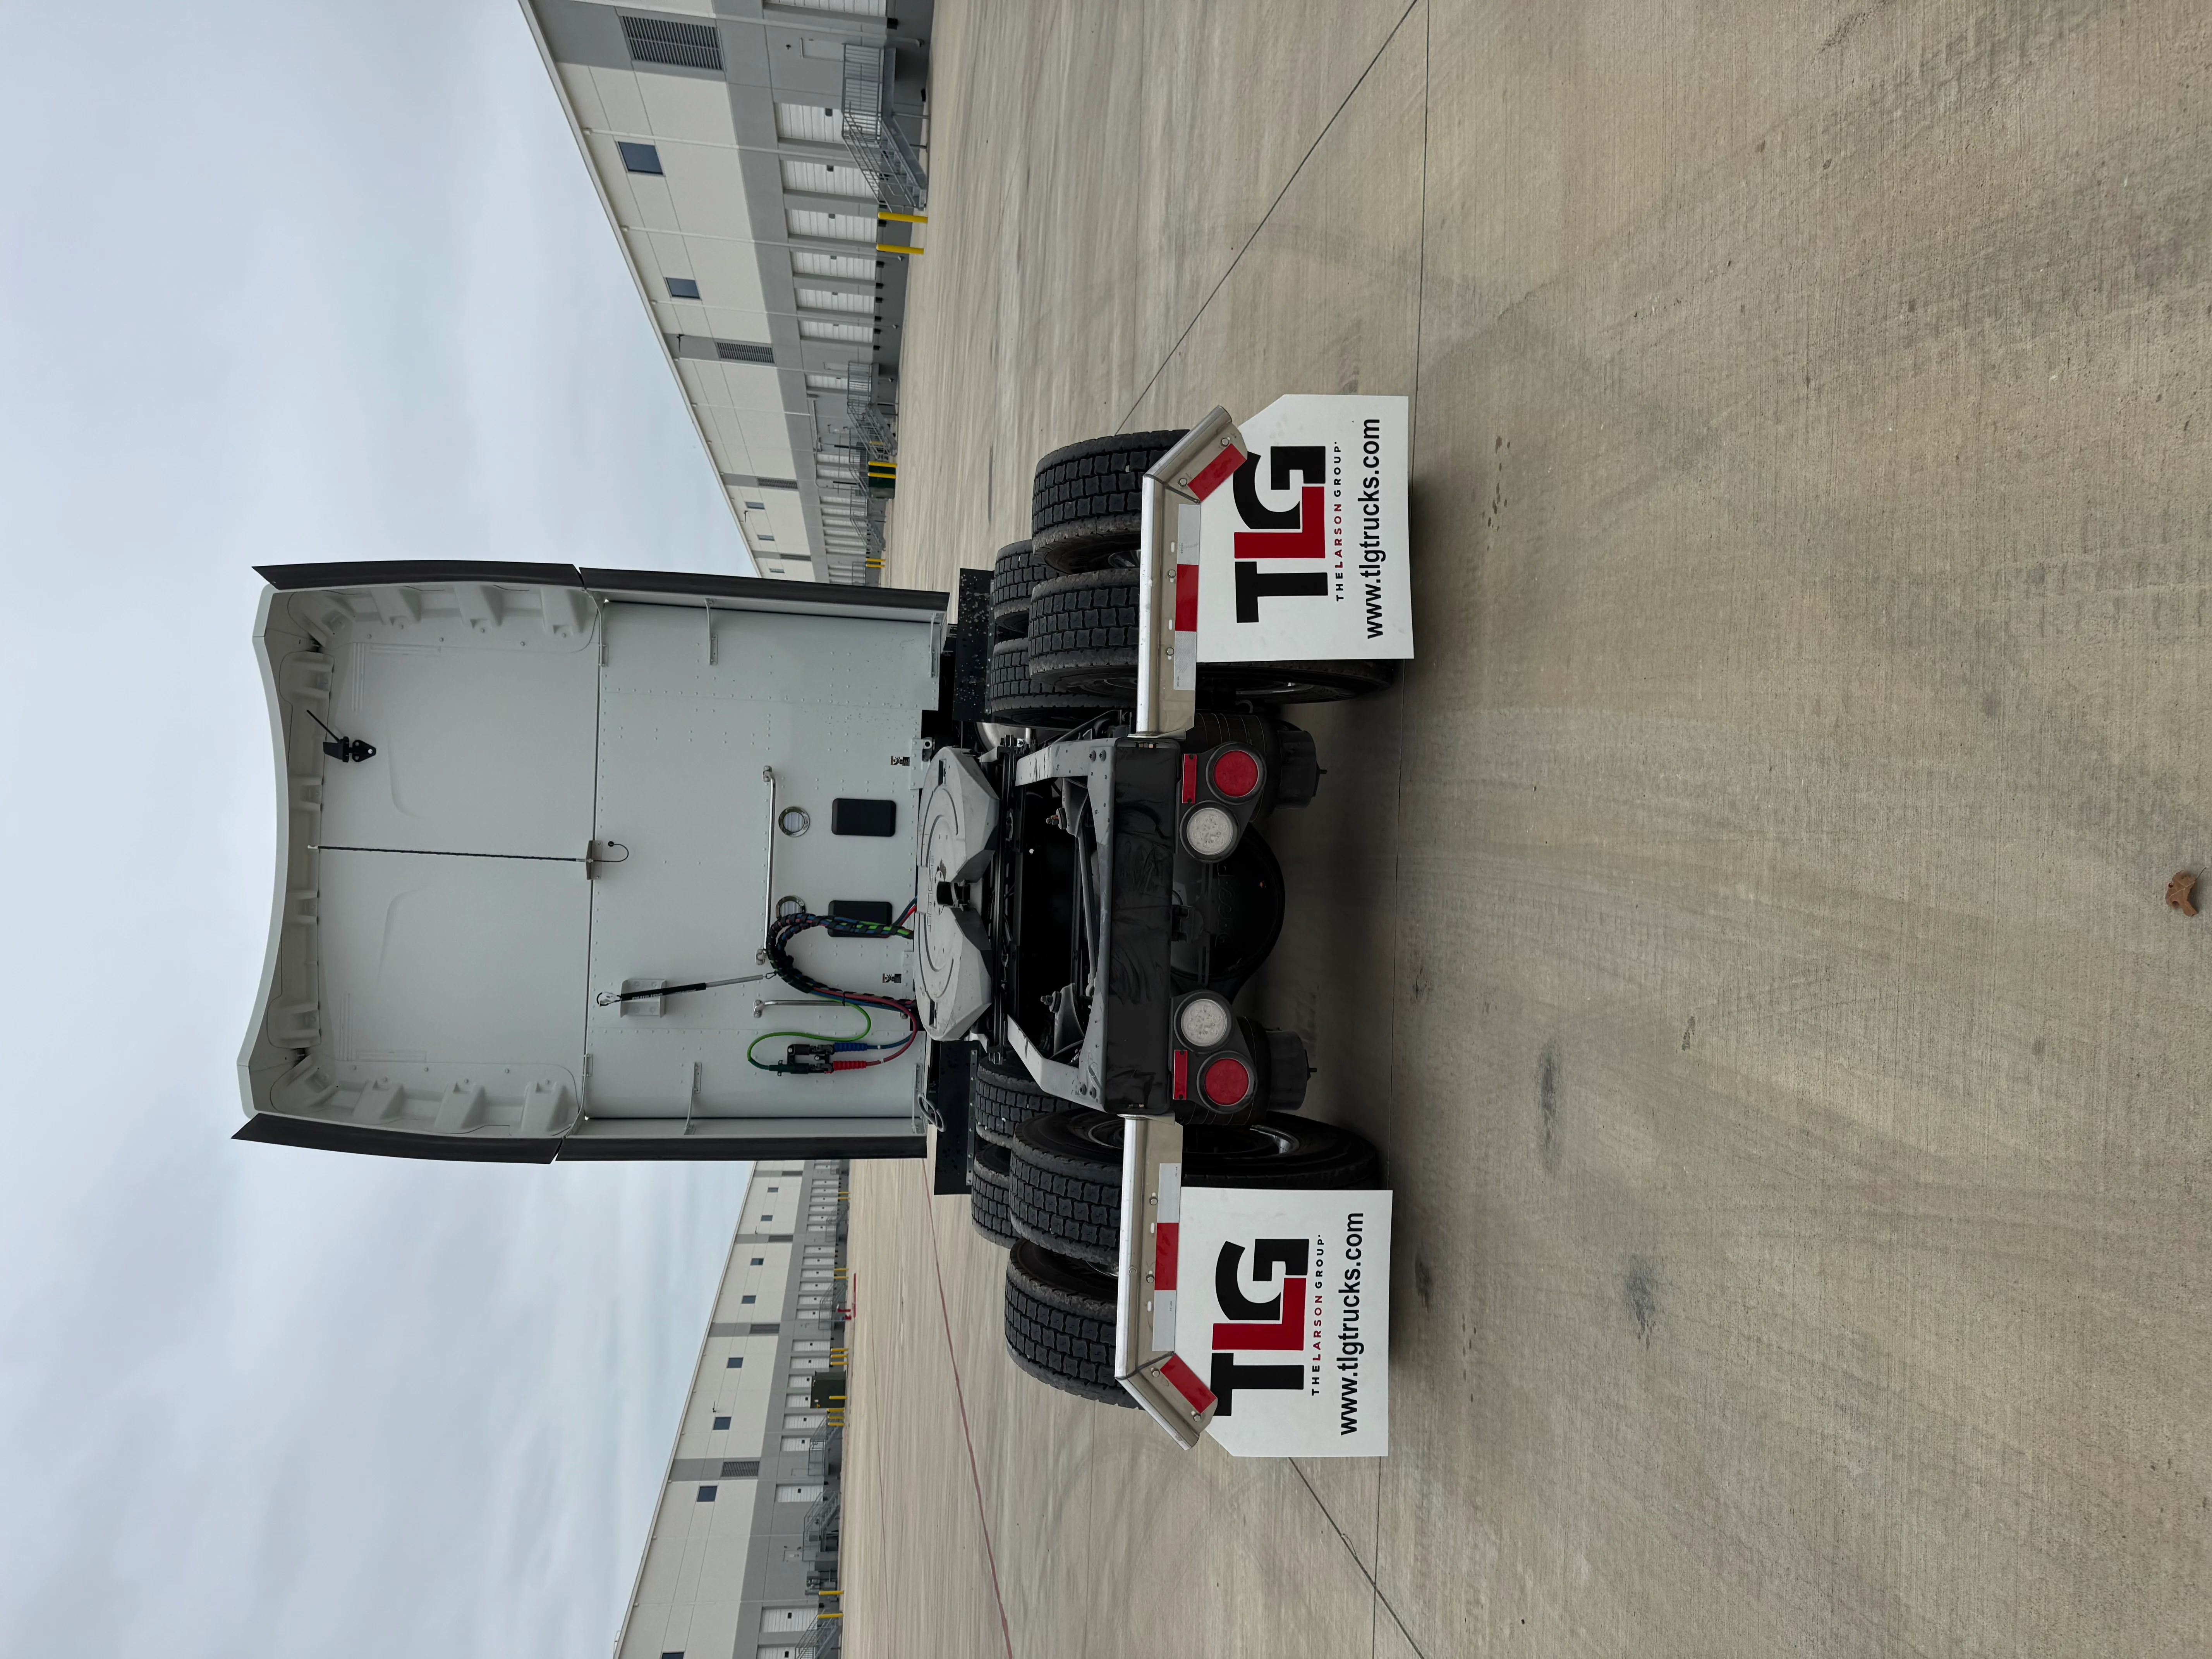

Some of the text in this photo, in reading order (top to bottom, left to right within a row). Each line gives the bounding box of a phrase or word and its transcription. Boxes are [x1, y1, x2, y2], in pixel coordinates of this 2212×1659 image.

[1233, 446, 1328, 623] TLG
[1334, 504, 1343, 568] LARSON
[1335, 572, 1344, 602] THE
[1357, 419, 1386, 639] www.tlgtrucks.com
[1211, 1239, 1309, 1416] TLG
[1311, 1239, 1324, 1396] THE LARSON GROUP
[1336, 1213, 1364, 1436] www.tlgtrucks.com
